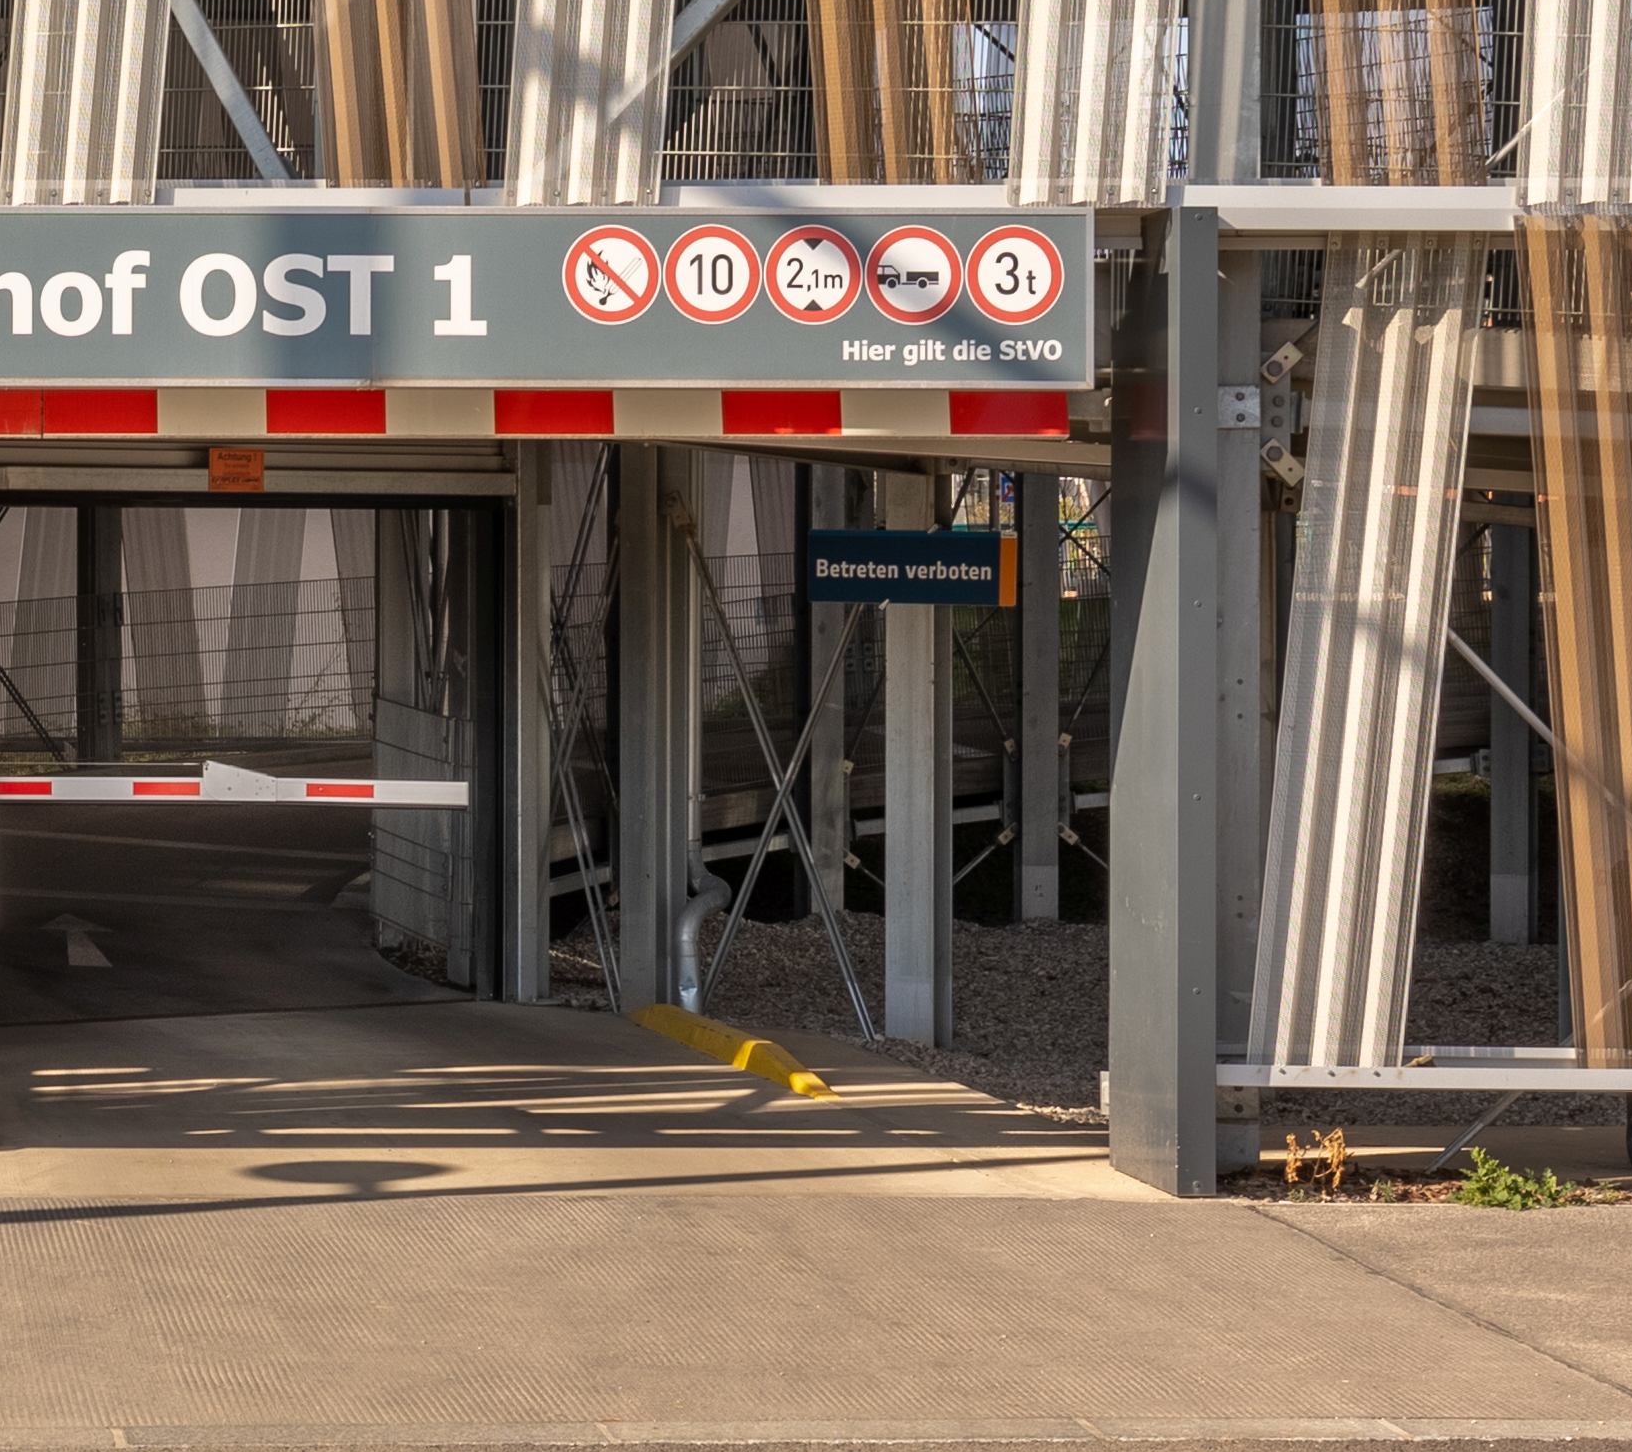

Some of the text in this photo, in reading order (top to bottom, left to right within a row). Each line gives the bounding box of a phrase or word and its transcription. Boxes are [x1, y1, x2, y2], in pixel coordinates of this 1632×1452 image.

[689, 254, 734, 295] 10
[179, 252, 394, 338] OST
[434, 254, 488, 336] 1
[842, 340, 1062, 366] Hier gilt die StVO
[816, 559, 992, 580] Betreten verboten
